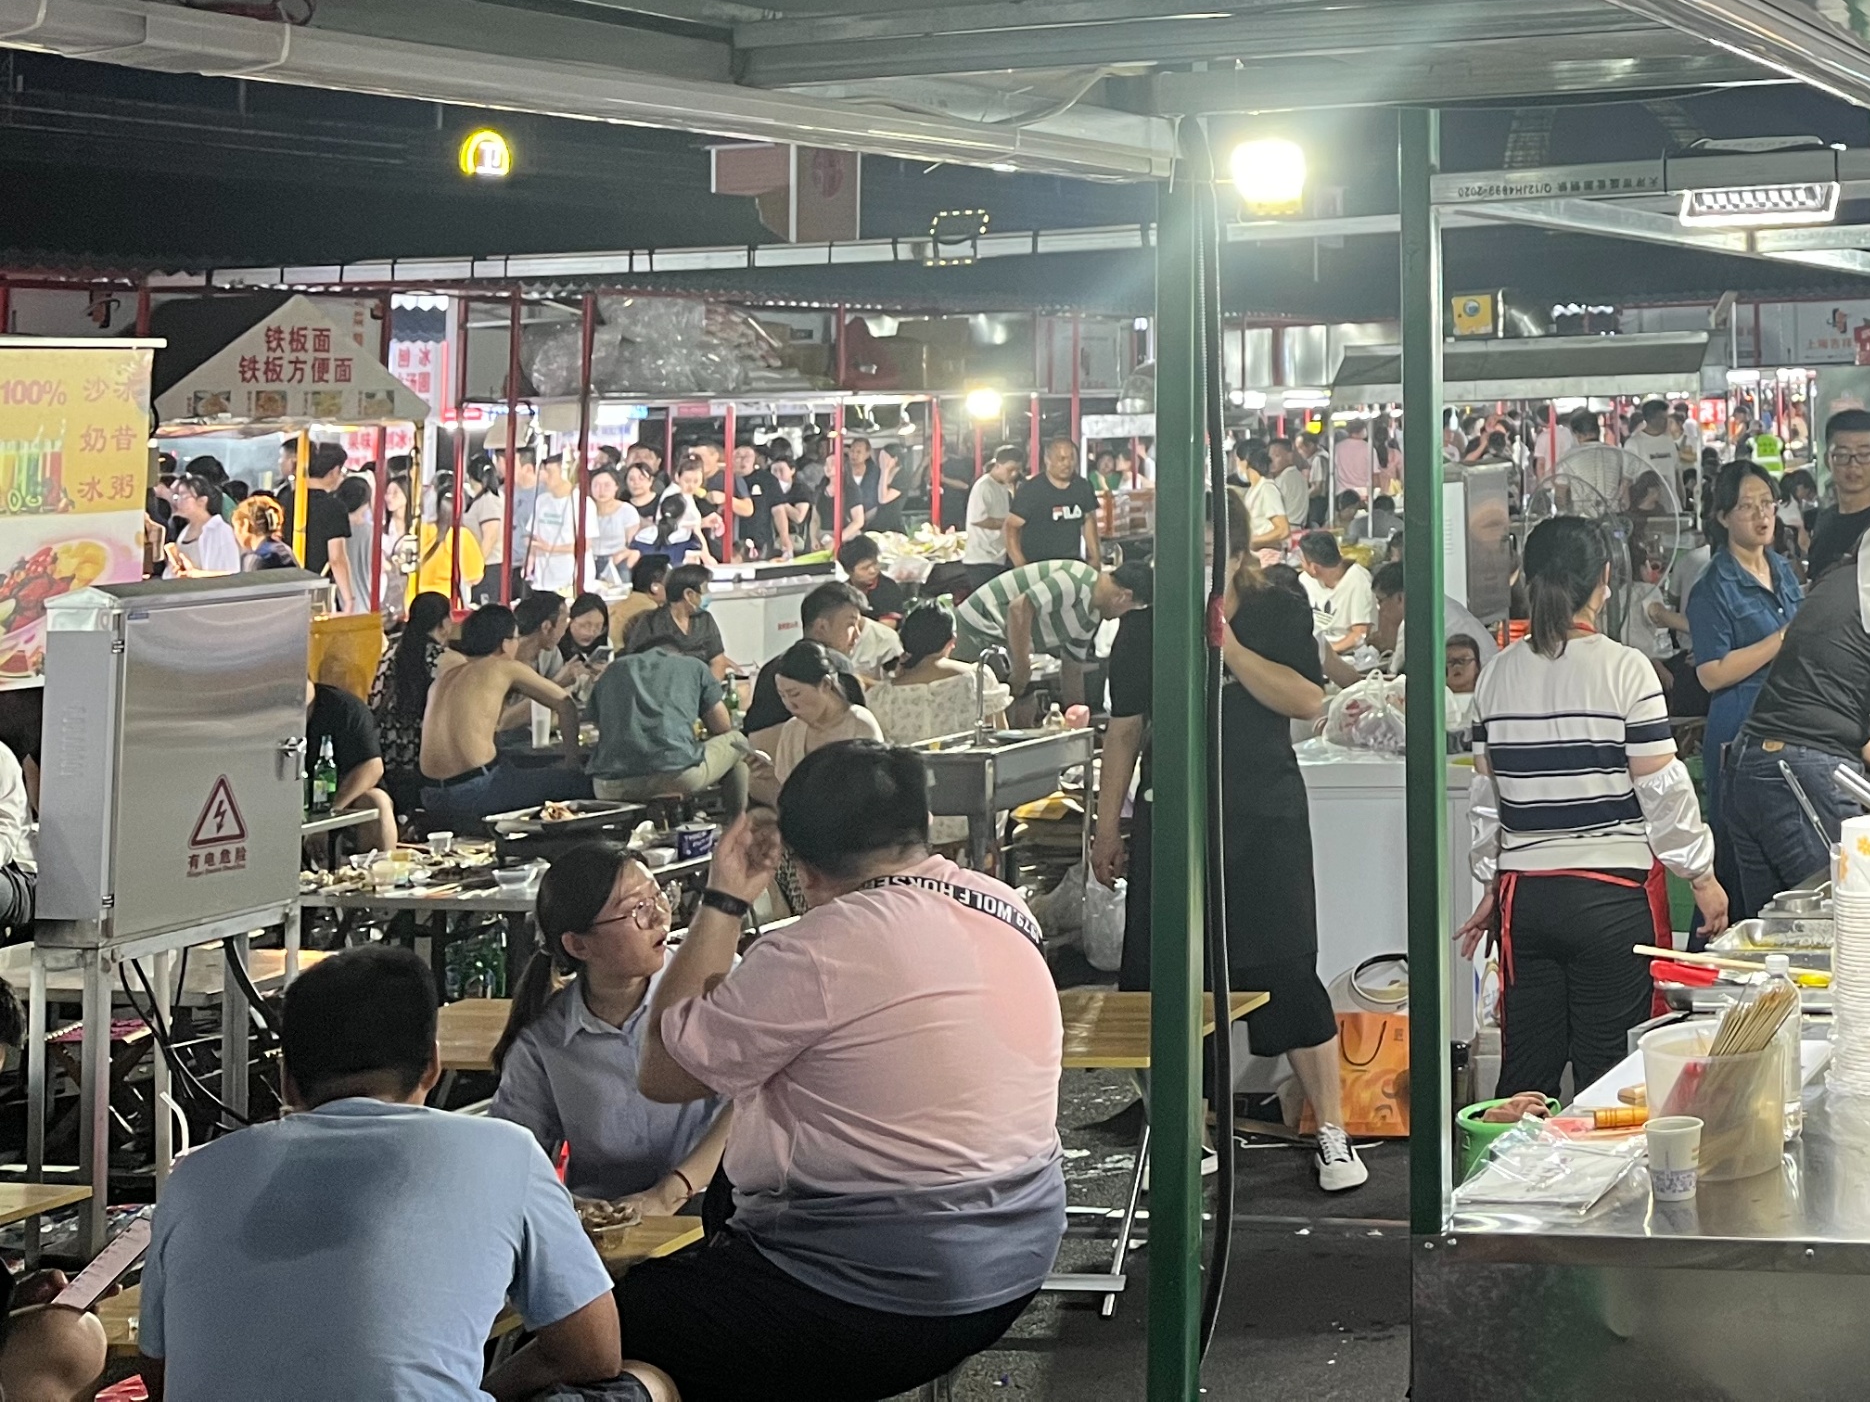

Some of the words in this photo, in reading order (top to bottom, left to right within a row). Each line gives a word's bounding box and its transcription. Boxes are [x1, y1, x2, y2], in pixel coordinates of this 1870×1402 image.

[265, 325, 331, 354] 铁板面
[238, 354, 354, 384] 铁板方便面
[0, 379, 67, 407] 100%
[79, 424, 138, 453] 奶昔
[77, 473, 135, 504] 冰粥
[1052, 504, 1083, 522] FILA
[188, 846, 247, 870] 有电危险
